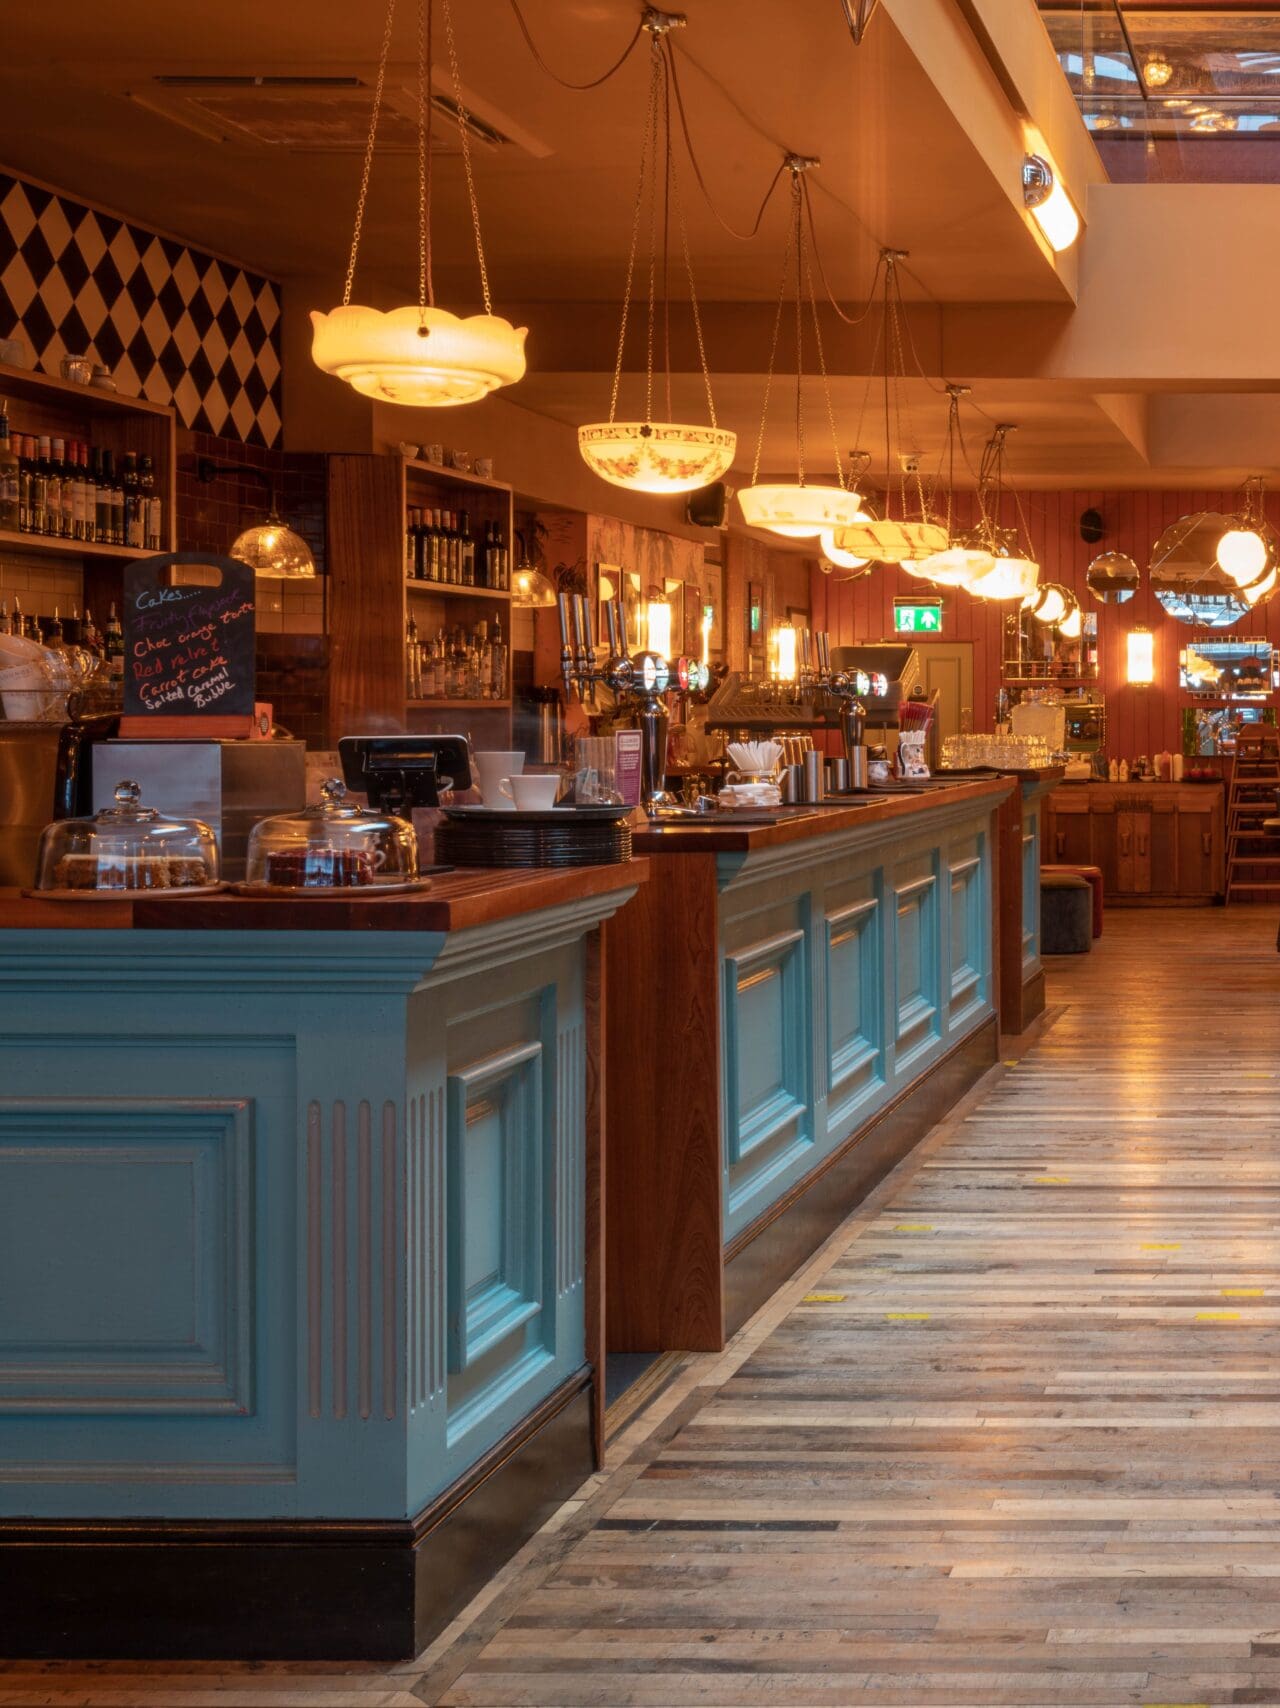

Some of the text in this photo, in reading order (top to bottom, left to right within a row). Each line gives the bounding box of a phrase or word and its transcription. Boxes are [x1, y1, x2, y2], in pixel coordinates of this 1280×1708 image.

[134, 637, 171, 657] Choc
[178, 623, 217, 643] orange
[133, 658, 163, 680] Red
[140, 655, 229, 701] Carrot cake
[145, 667, 230, 710] Salted Caramel
[194, 681, 236, 708] Bubble
